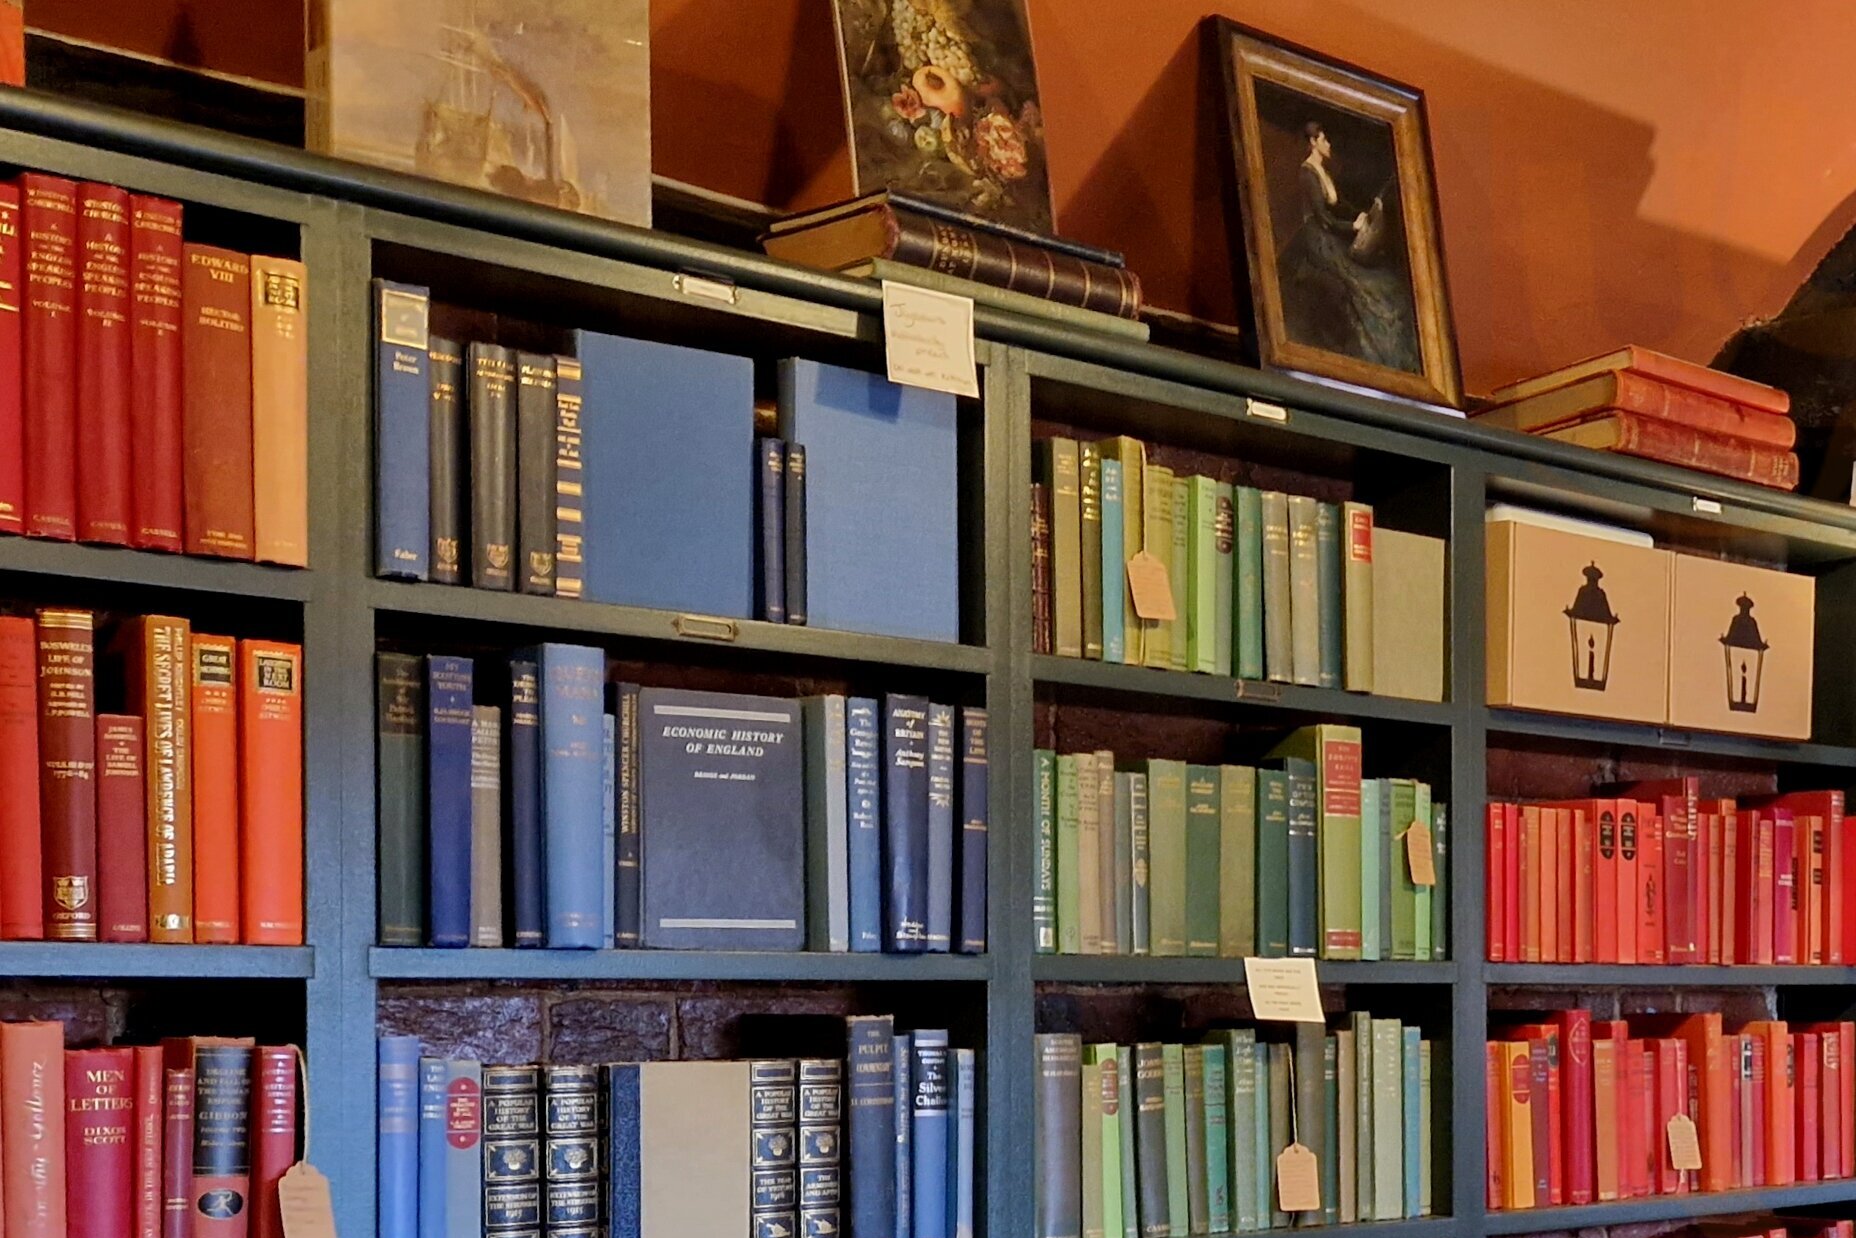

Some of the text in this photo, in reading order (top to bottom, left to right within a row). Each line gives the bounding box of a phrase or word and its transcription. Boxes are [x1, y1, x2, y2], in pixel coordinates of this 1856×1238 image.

[31, 232, 72, 244] HISTORY
[86, 241, 124, 255] HISTORY
[32, 251, 72, 265] ENGLISH
[191, 253, 249, 275] EDWARD
[30, 274, 72, 288] PEOPLES
[210, 270, 234, 284] VIII
[201, 306, 241, 322] HECTOR
[200, 317, 244, 333] BOLITHO
[394, 351, 419, 362] Peter
[154, 626, 171, 651] THE
[48, 654, 86, 664] LIFE OF
[202, 655, 227, 665] GREAT
[40, 666, 93, 678] JOHNSON
[154, 653, 172, 702] SECRET
[264, 680, 290, 690] ROOM
[438, 682, 466, 692] YOUTH
[893, 707, 926, 721] ANATOMY
[154, 703, 173, 738] LIVES
[906, 720, 915, 729] of
[662, 726, 783, 744] ECONOMIC HISTORY
[895, 728, 924, 740] BRITAIN
[160, 740, 174, 757] OF
[686, 743, 764, 758] OF ENGLAND
[895, 748, 925, 761] Anthony
[621, 694, 630, 834] WINSTON SPENCER CHURCHILL
[730, 772, 756, 781] JORDAN
[1040, 757, 1051, 891] A MONTH OF SUNDAYS
[161, 824, 175, 841] OF
[52, 911, 90, 920] OXFORD
[858, 1043, 888, 1055] PULPIT
[86, 1070, 126, 1082] MEN
[927, 1071, 943, 1081] The
[95, 1084, 114, 1095] OF
[70, 1098, 133, 1113] LETTERS
[498, 1099, 534, 1108] POPULAR
[561, 1098, 595, 1107] POPULAR
[198, 1111, 248, 1120] GIBBON
[494, 1107, 530, 1115] HISTORY
[556, 1107, 591, 1115] HISTORY
[558, 1114, 588, 1123] OF THE
[83, 1126, 126, 1137] DIXON
[488, 1123, 514, 1132] GREAT
[551, 1122, 577, 1131] GREAT
[83, 1135, 126, 1146] SCOTT
[506, 1208, 523, 1219] 1915
